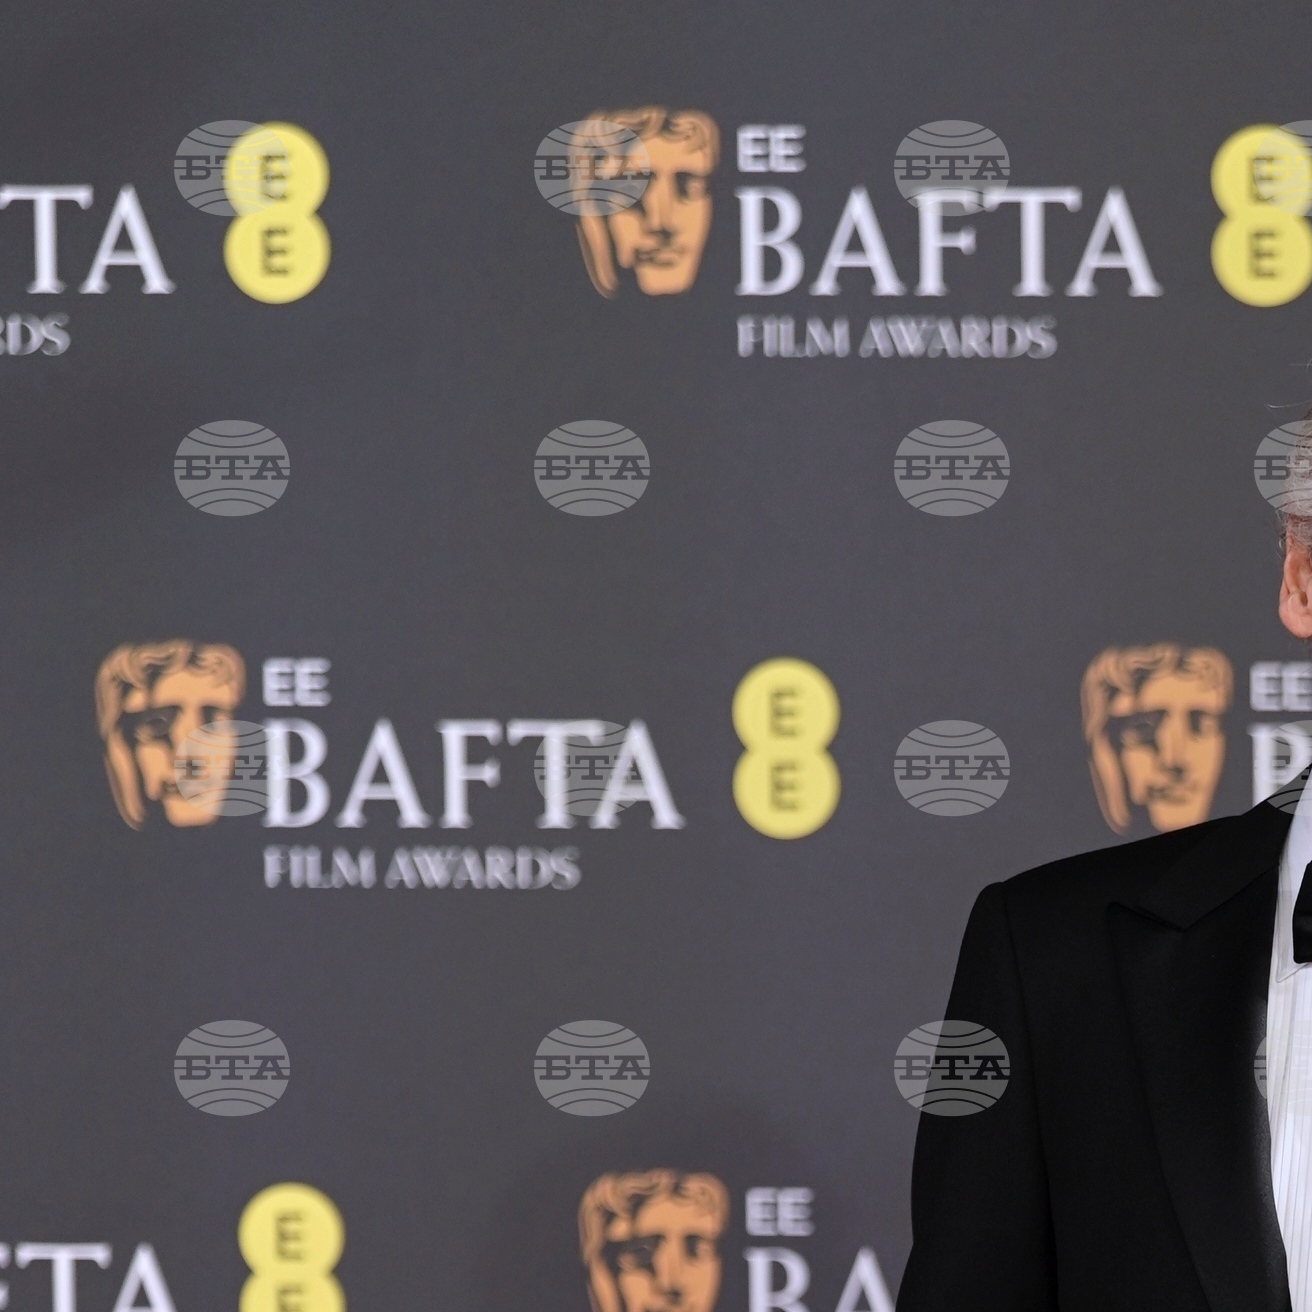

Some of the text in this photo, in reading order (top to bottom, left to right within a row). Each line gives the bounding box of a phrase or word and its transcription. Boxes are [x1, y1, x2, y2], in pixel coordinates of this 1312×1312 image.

[737, 124, 806, 173] EE
[734, 185, 1164, 297] BAFTA
[0, 312, 71, 356] DS
[737, 315, 1058, 359] FILM AWARDS
[262, 657, 332, 707] EE
[260, 717, 687, 830] BAFTA
[263, 843, 581, 891] FILM AWARDS
[745, 1186, 815, 1237] EE
